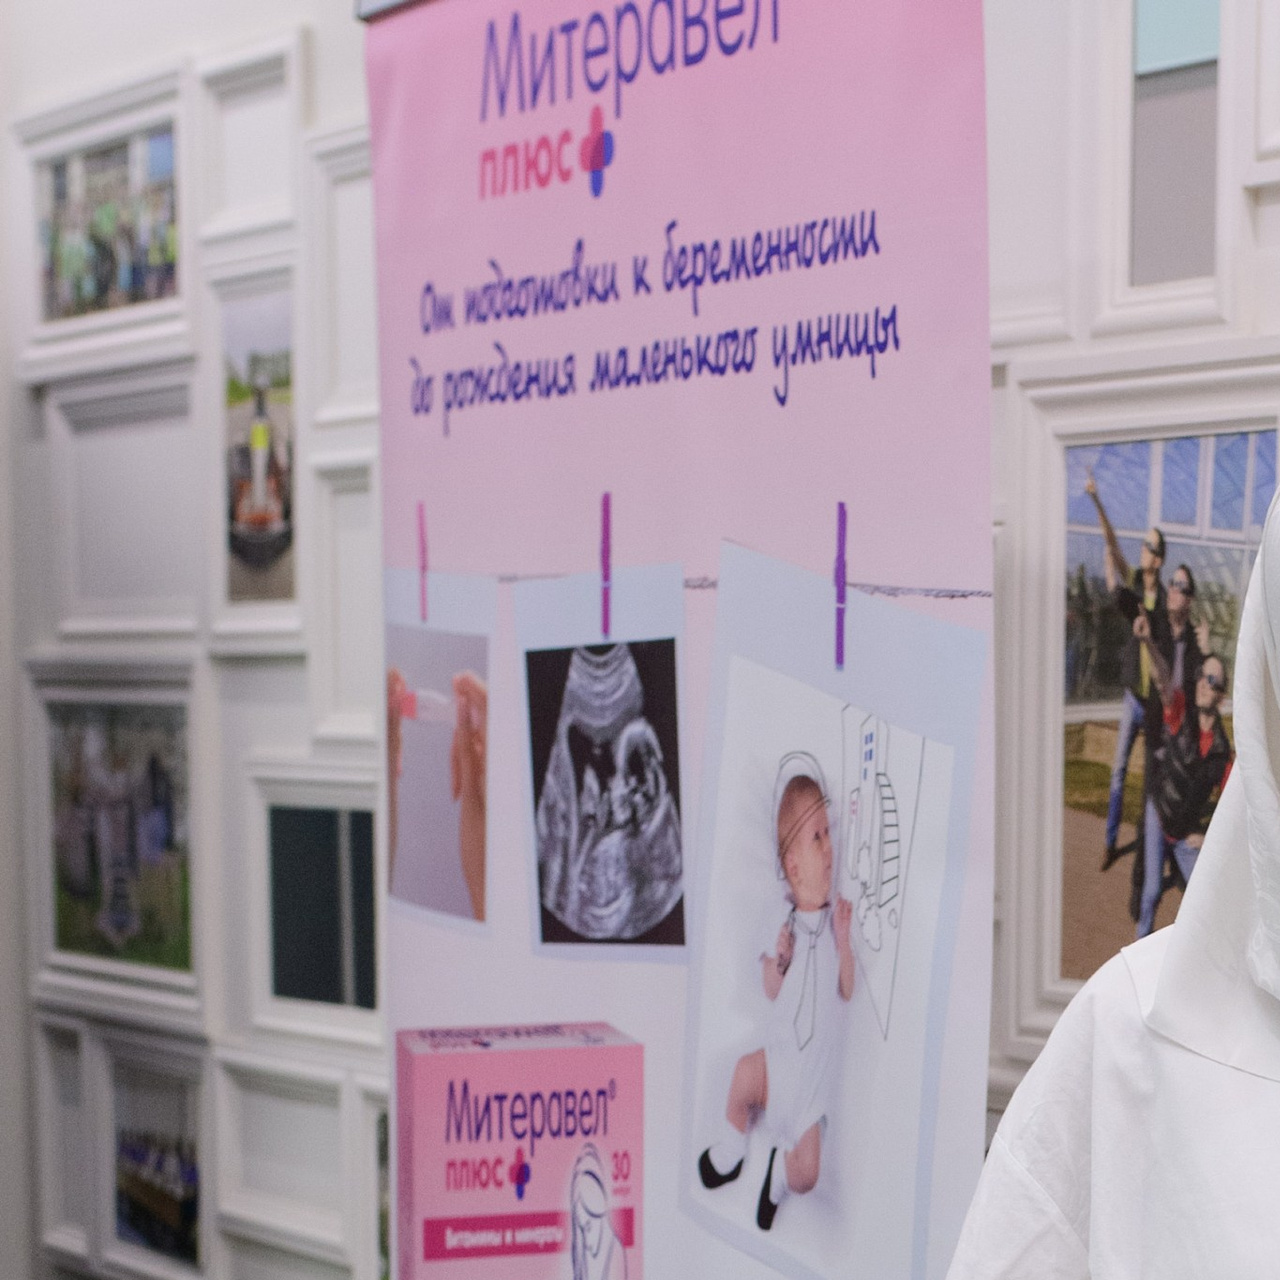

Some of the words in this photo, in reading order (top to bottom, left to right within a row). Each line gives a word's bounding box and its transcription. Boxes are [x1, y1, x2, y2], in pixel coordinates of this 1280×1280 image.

[479, 0, 779, 121] Митеравел
[419, 281, 455, 335] От
[464, 238, 619, 324] подготовки
[632, 256, 651, 295] к
[662, 209, 881, 317] беременности
[408, 356, 434, 416] до
[442, 341, 576, 437] рождения
[589, 325, 758, 393] маленького
[771, 303, 901, 406] умницы
[611, 1150, 631, 1182] 30
